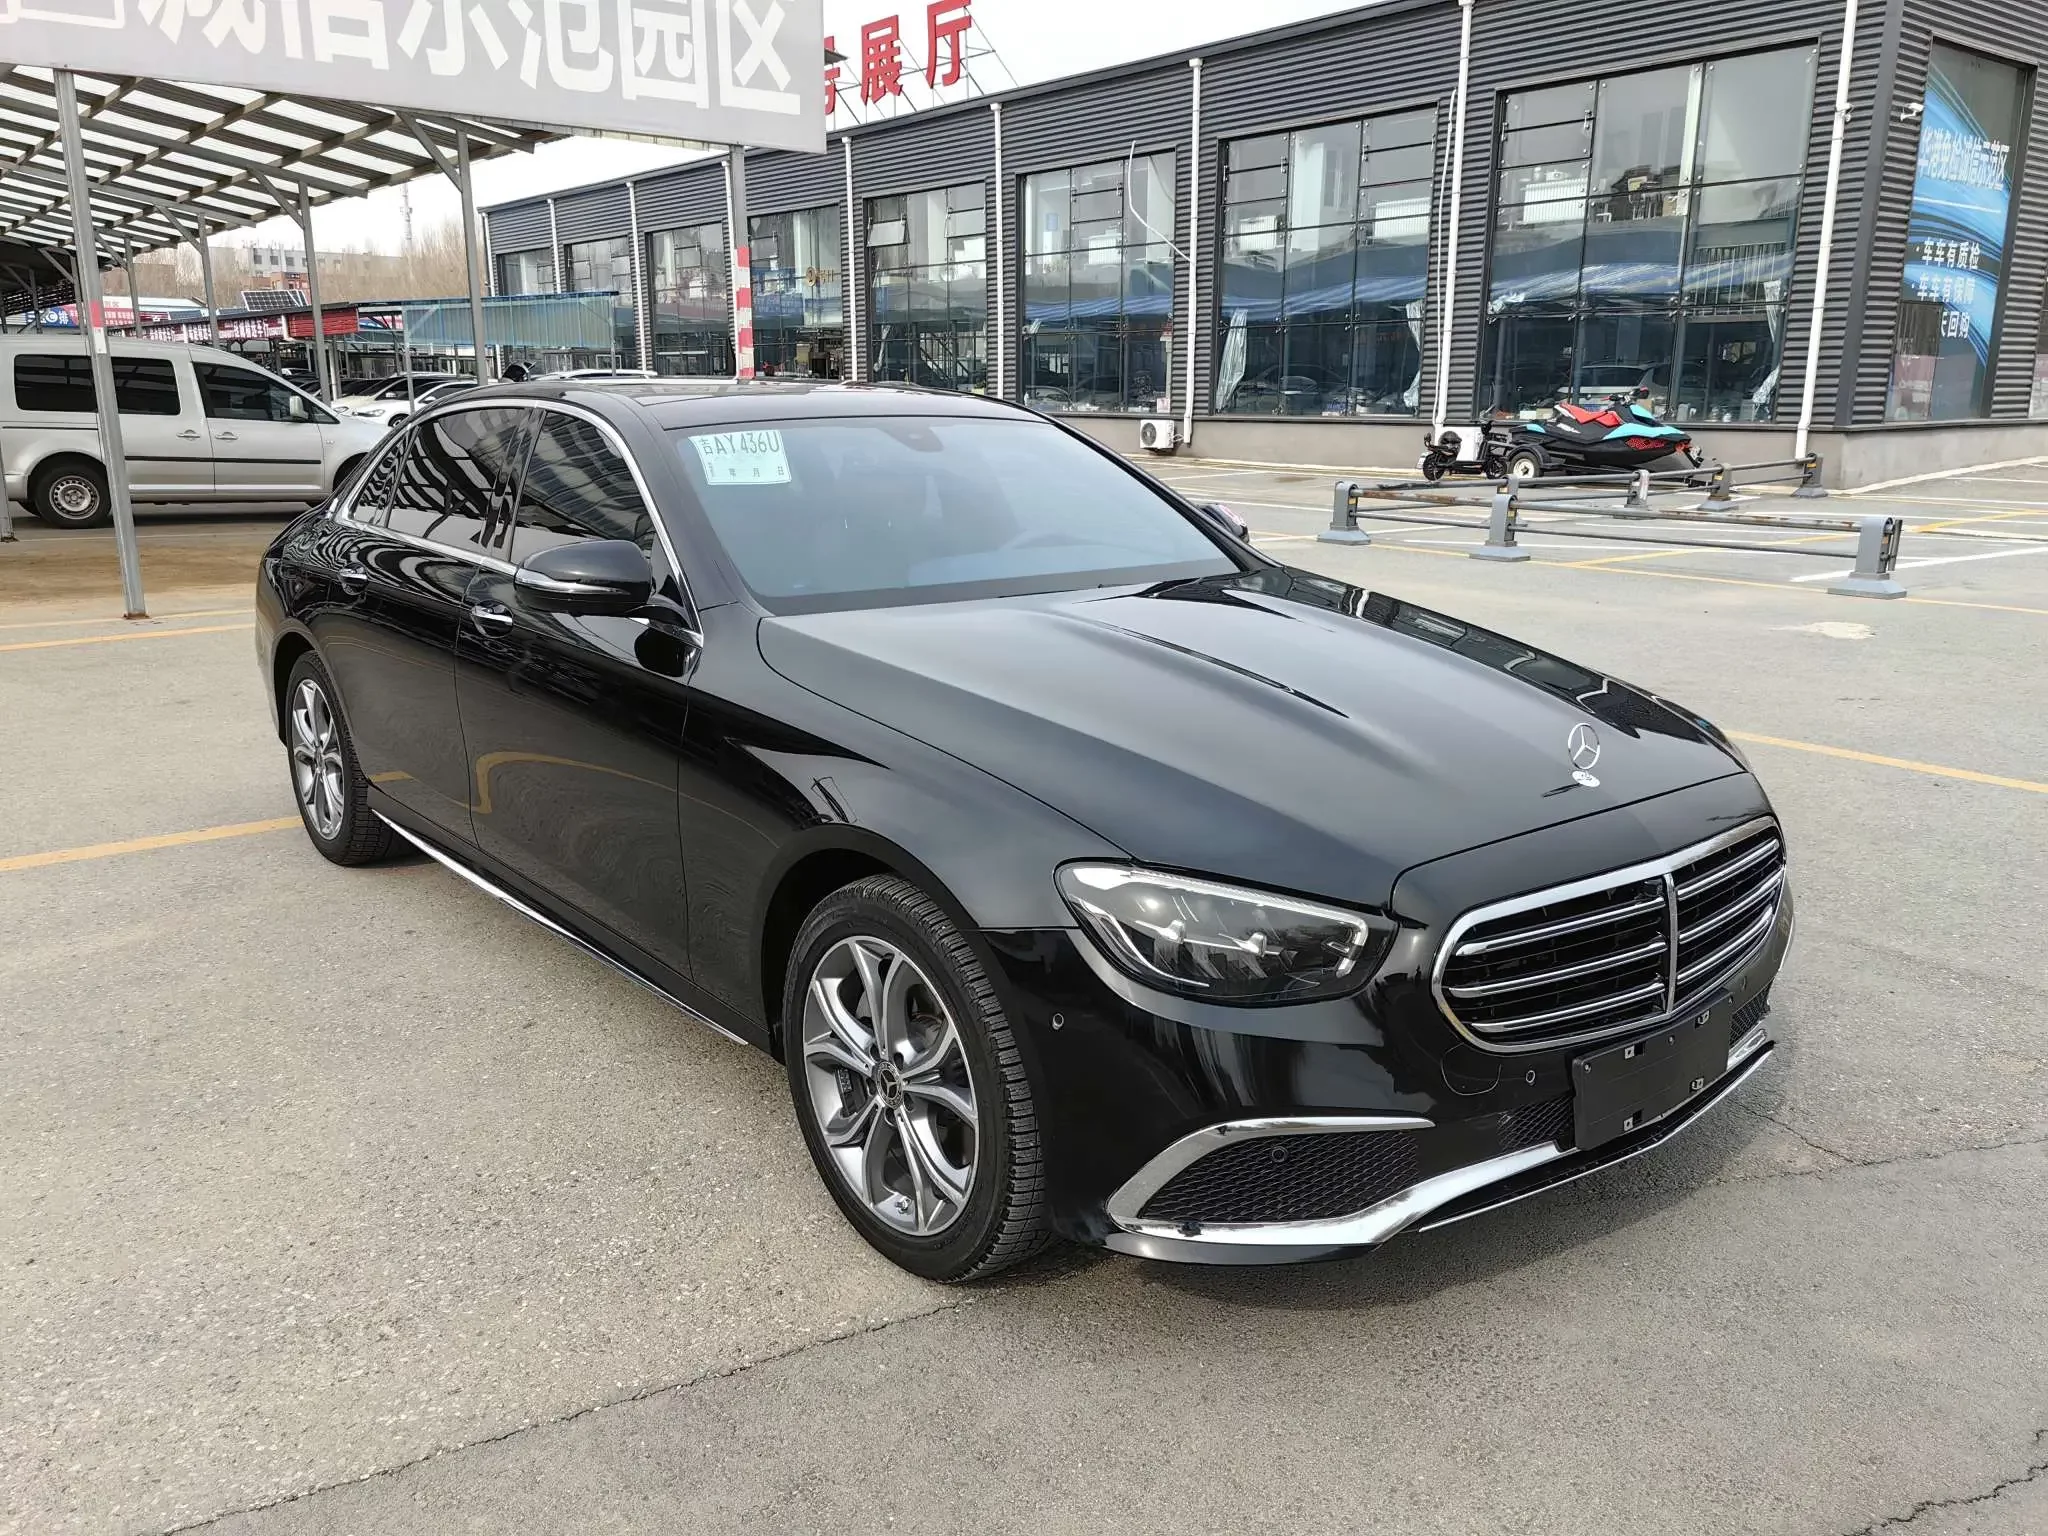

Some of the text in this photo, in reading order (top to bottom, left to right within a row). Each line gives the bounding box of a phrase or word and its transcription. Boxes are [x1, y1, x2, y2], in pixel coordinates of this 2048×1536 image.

[1922, 237, 1981, 269] 车车有质检
